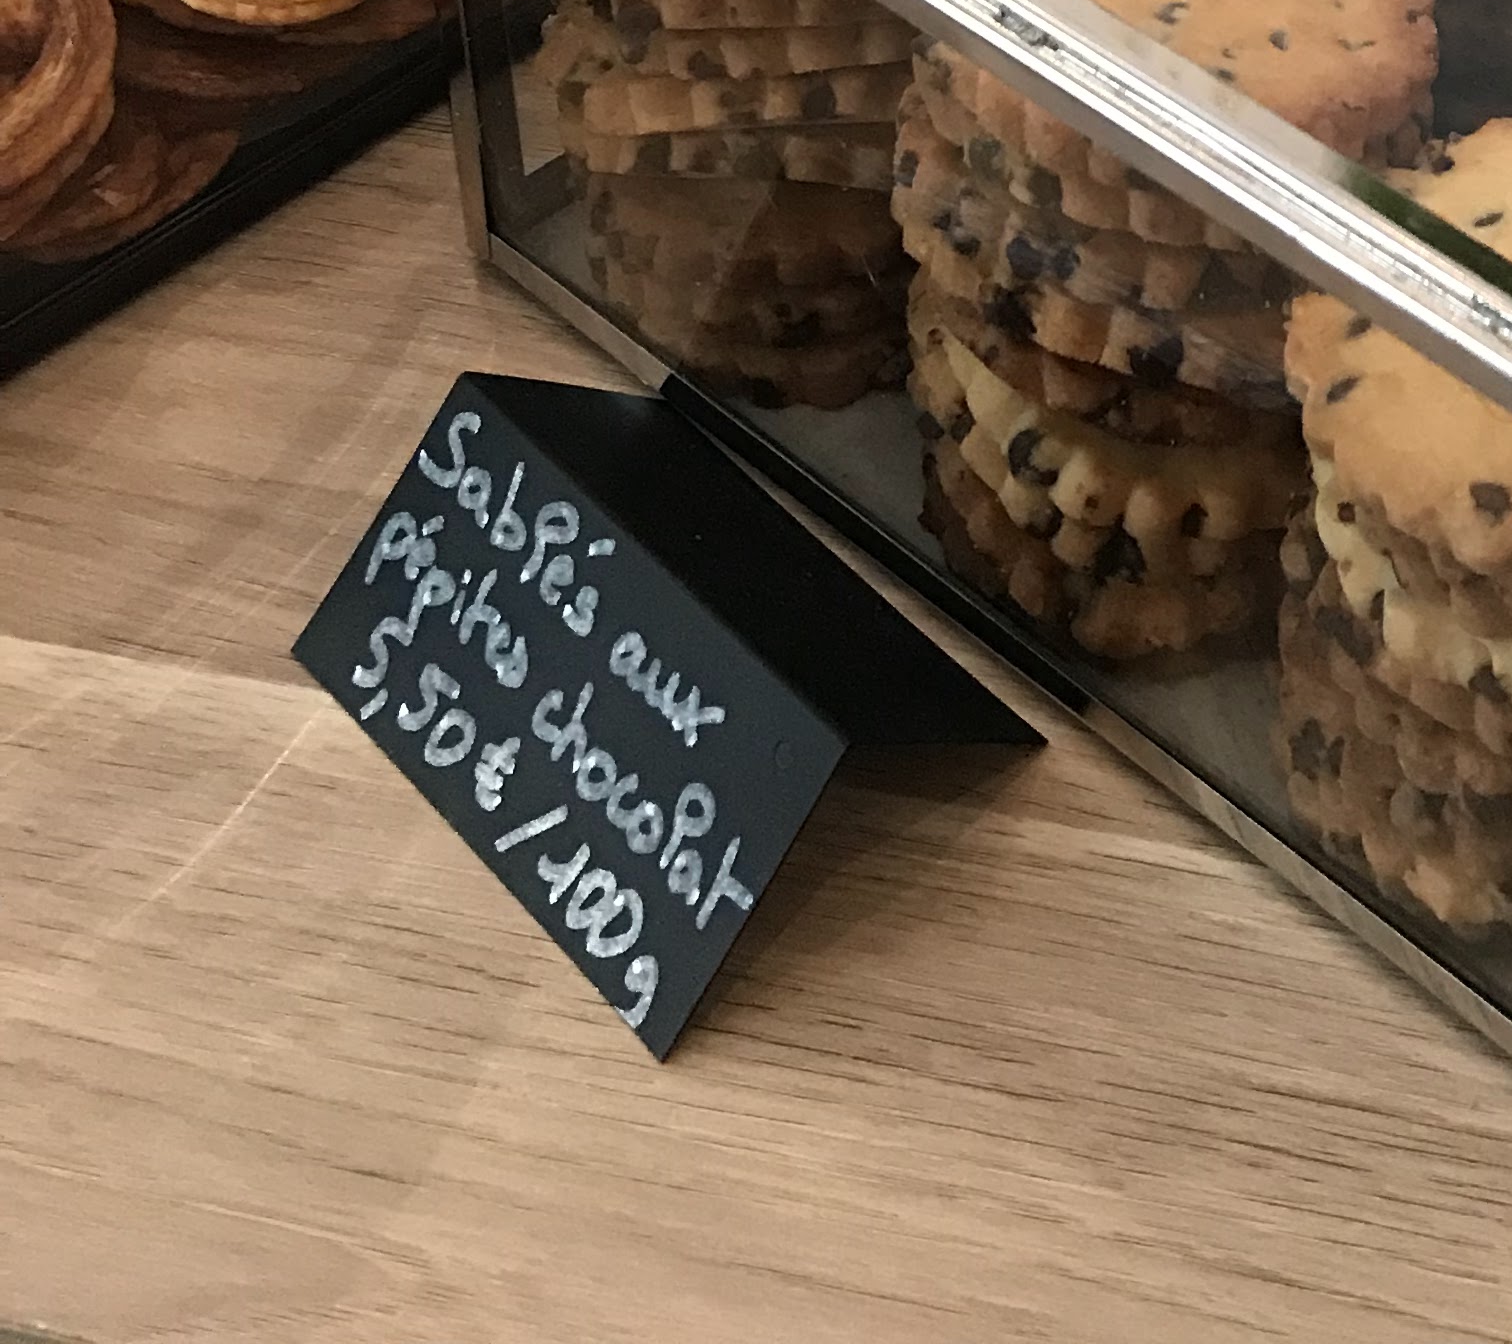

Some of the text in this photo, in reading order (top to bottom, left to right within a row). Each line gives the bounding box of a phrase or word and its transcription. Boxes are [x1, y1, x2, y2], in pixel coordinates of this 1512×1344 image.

[418, 411, 726, 748] Sablés aux
[532, 680, 755, 930] chocolat
